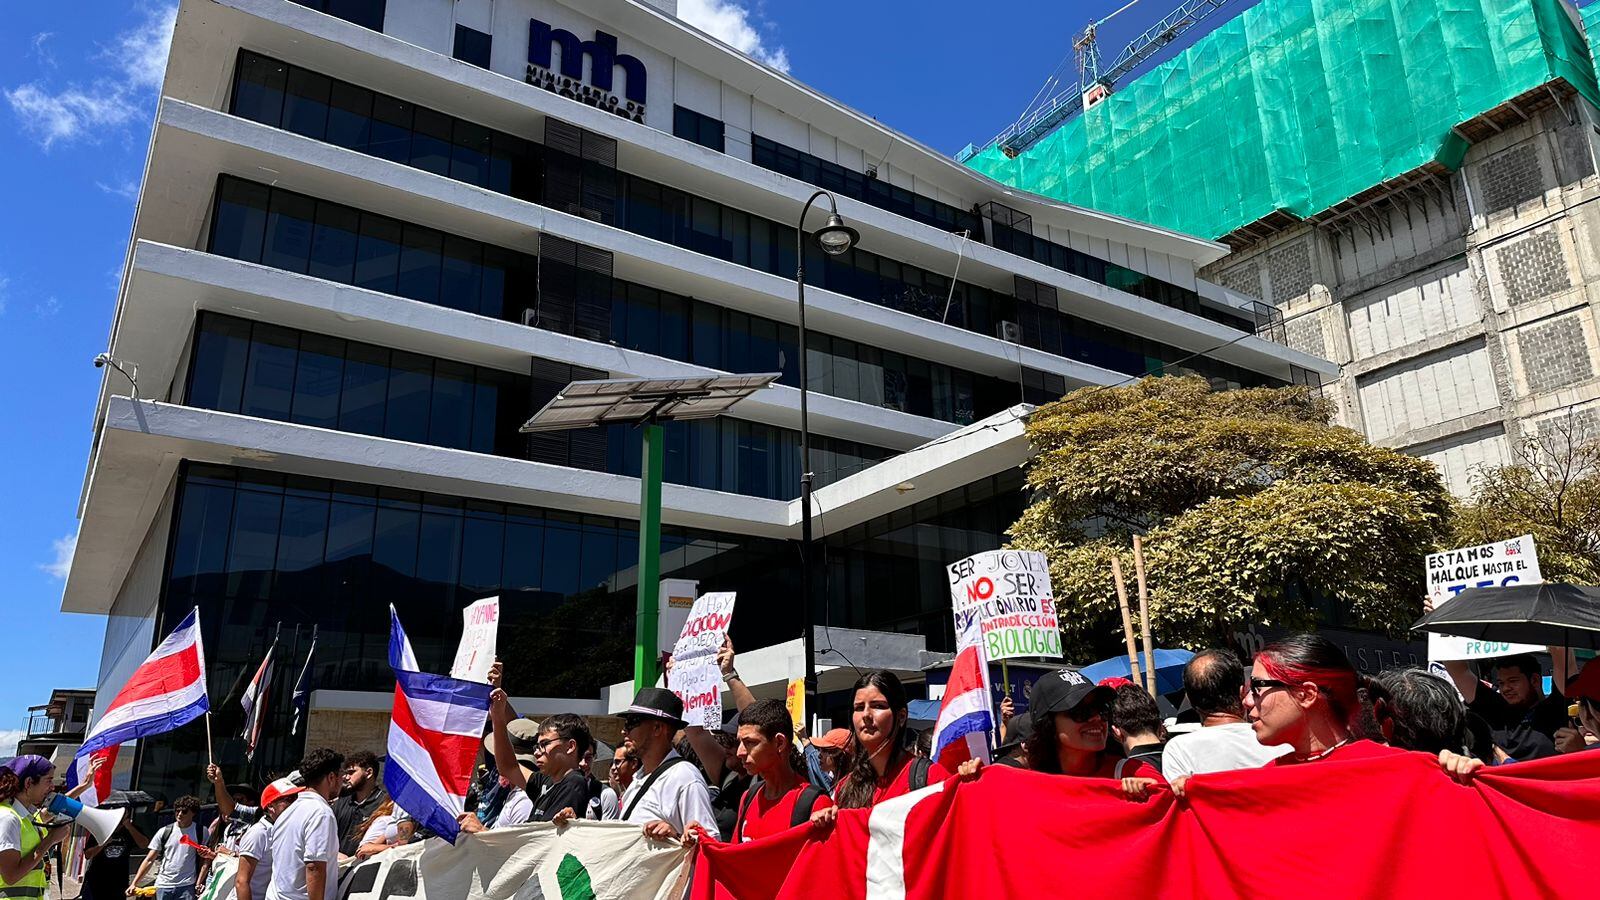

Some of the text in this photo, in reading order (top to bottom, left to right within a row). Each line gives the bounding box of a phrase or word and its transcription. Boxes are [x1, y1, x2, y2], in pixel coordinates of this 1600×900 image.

[528, 18, 647, 104] mh
[527, 64, 645, 115] MINISTERIO DE
[951, 551, 1046, 585] SER JOVEN
[1429, 546, 1494, 569] ESTAMOS
[1483, 561, 1513, 577] HASTA
[1517, 560, 1527, 570] EL
[966, 576, 994, 605] NO
[1003, 573, 1037, 596] SER
[1040, 598, 1056, 614] ES
[981, 613, 1056, 634] ONTRADICCIÓN
